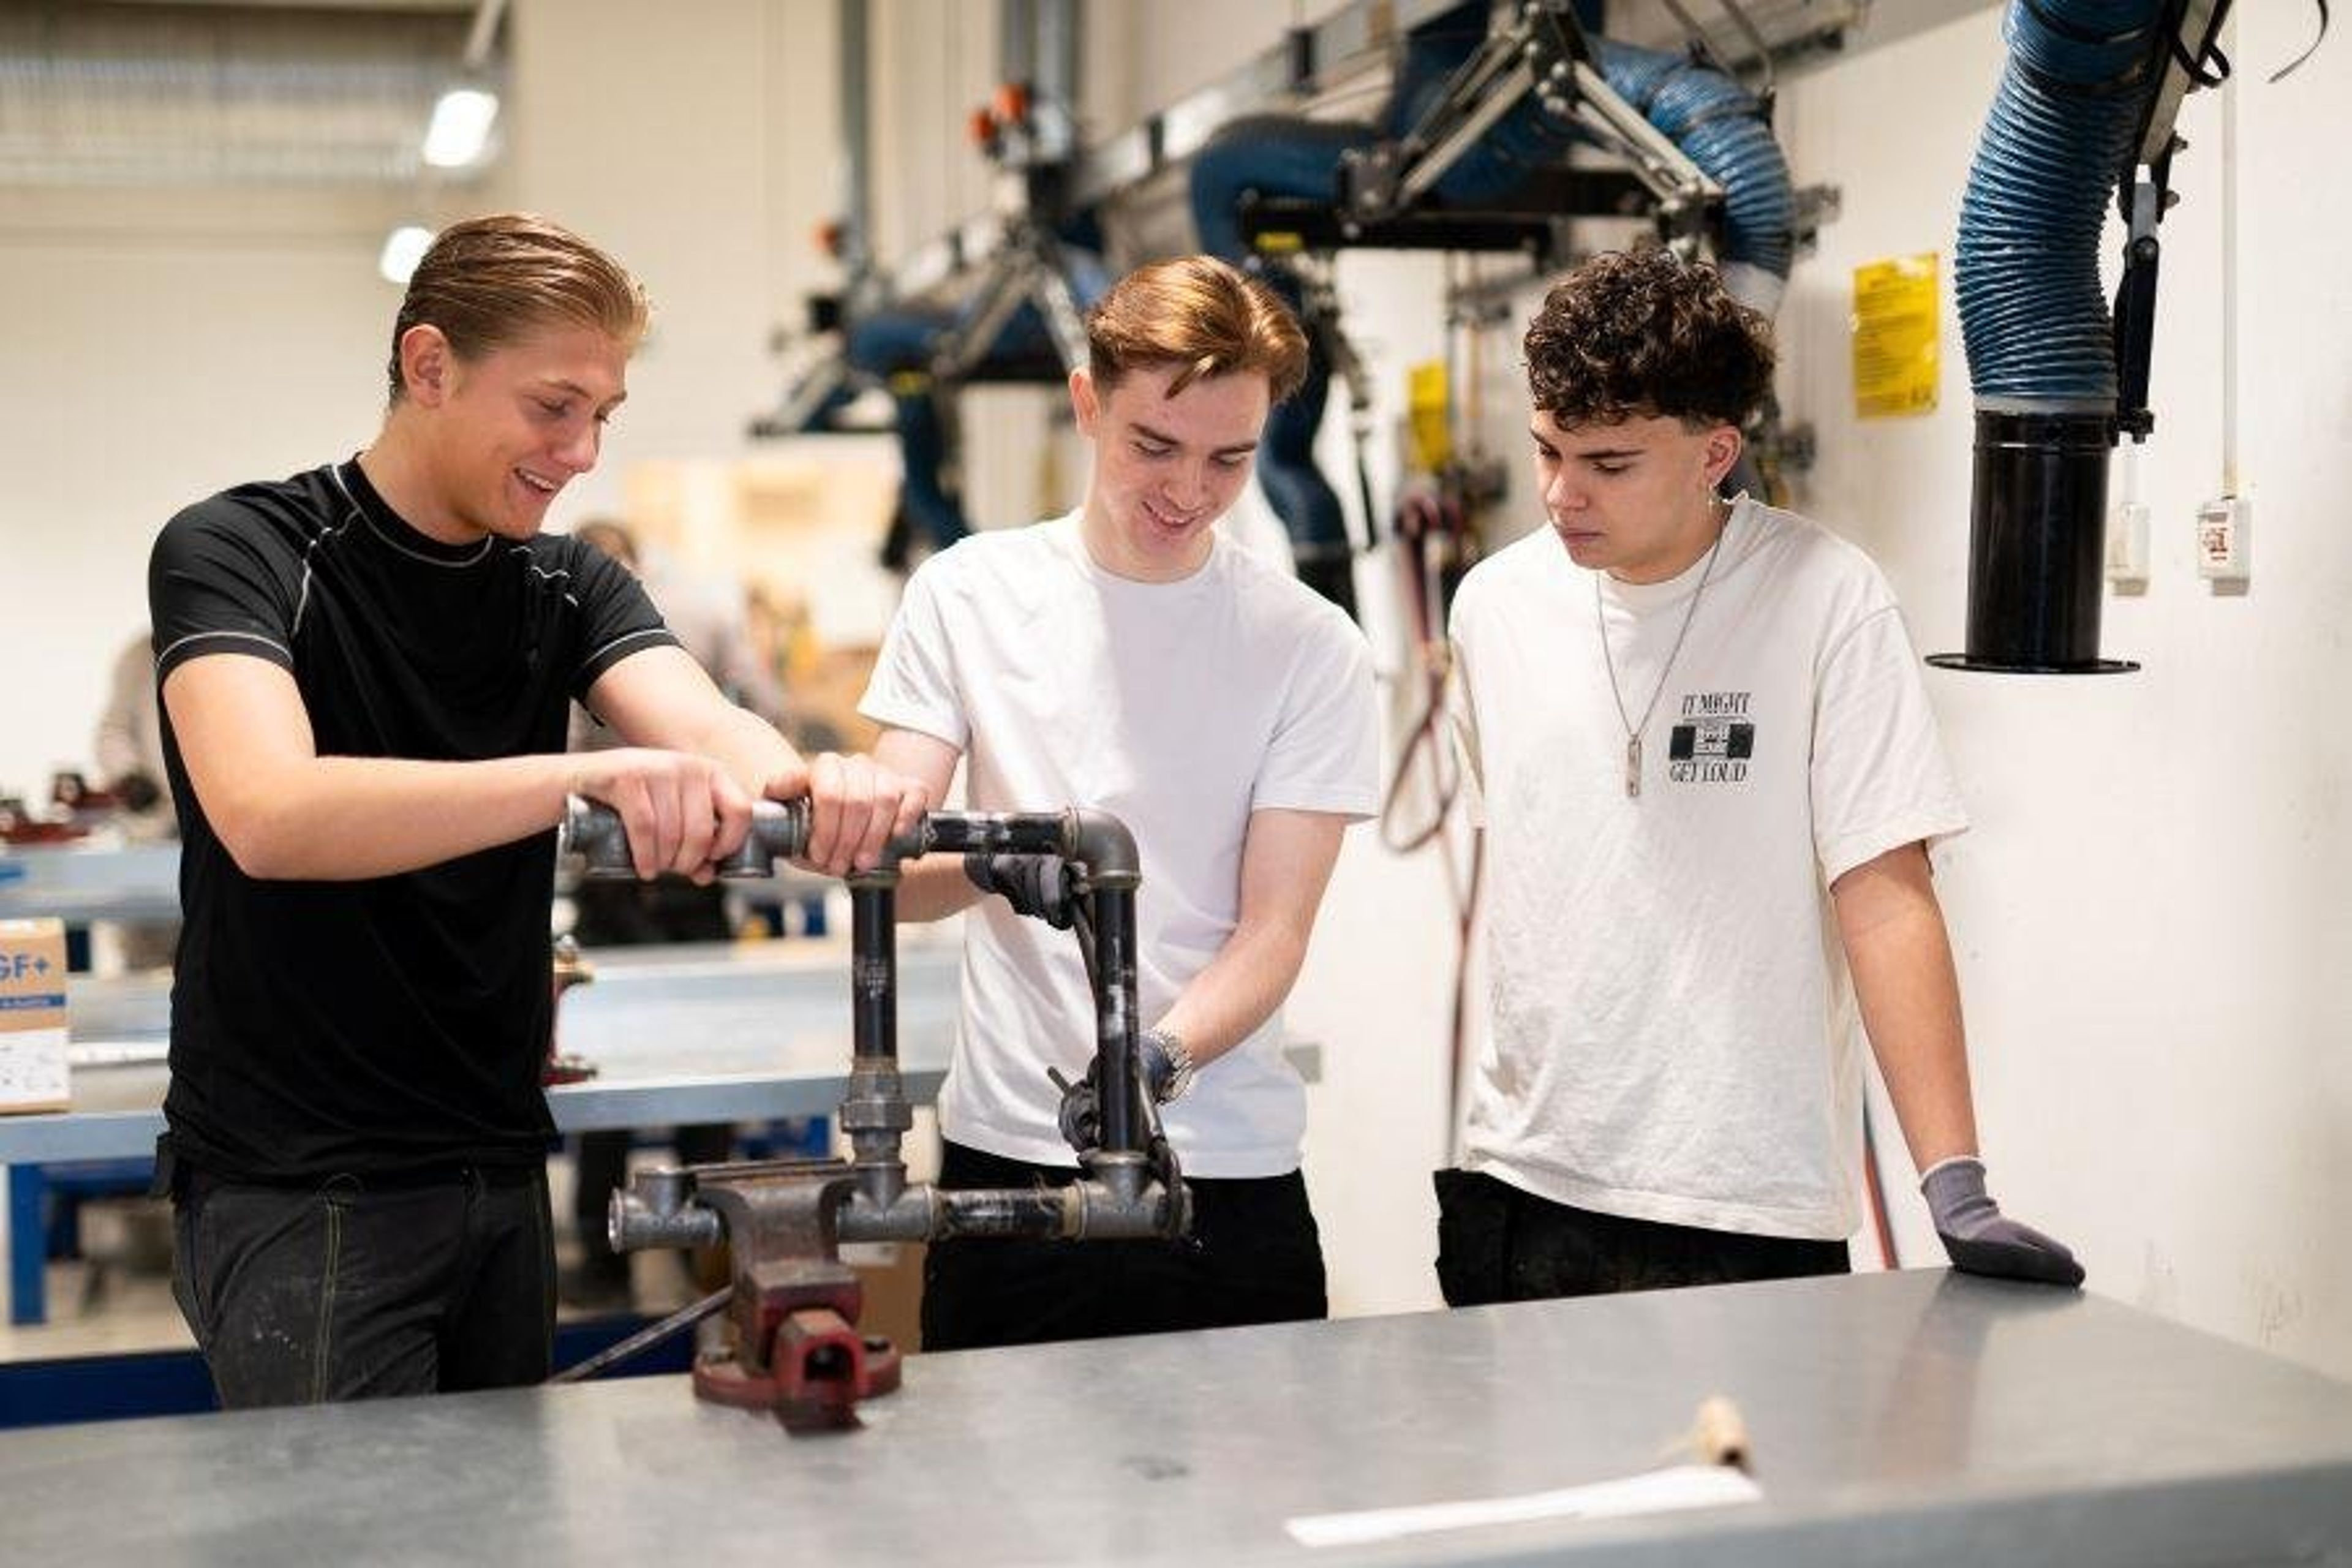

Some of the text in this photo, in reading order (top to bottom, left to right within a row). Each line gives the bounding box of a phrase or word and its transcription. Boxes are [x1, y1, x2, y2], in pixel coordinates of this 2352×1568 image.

[1683, 692, 1751, 714] IT MIGHT
[1670, 761, 1746, 782] GET LOUD
